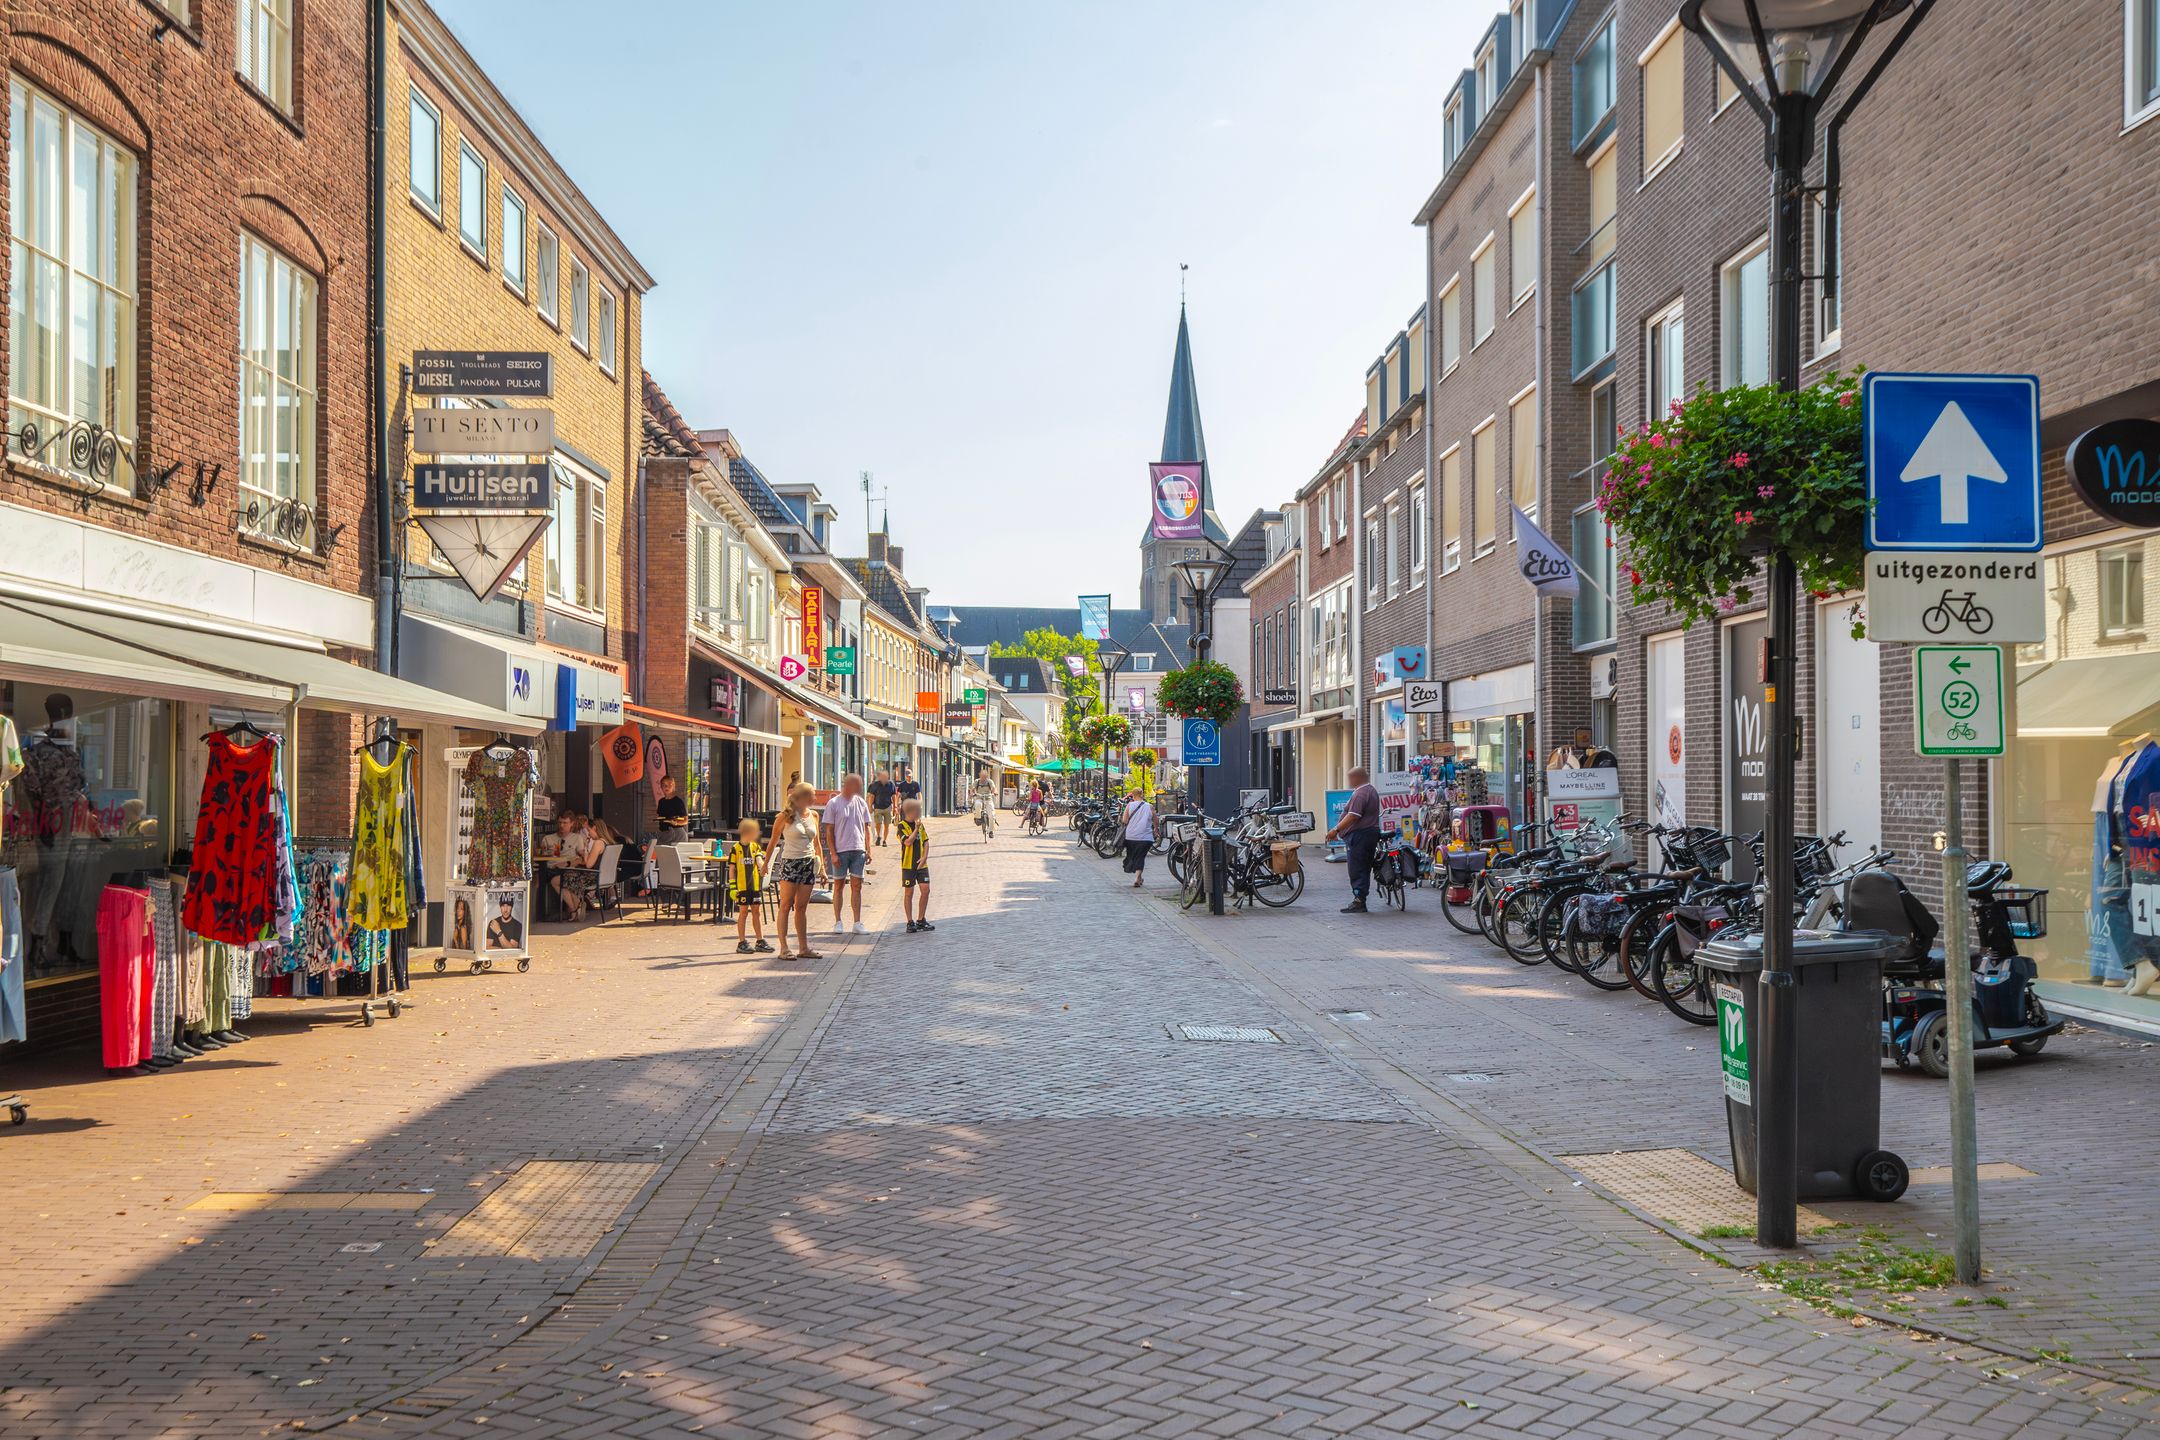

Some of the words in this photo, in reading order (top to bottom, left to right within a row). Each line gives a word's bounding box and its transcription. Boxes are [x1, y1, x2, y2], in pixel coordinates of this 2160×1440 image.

[419, 359, 455, 368] FOSSIL
[461, 361, 501, 369] TROLLBEADS
[506, 360, 542, 369] SEIKO
[419, 373, 455, 387] DIESEL
[506, 379, 541, 388] PULSAR
[423, 417, 445, 433] TI
[459, 417, 539, 433] SENTO
[424, 469, 539, 501] Huijsen
[445, 494, 477, 502] juwelier
[1523, 549, 1571, 578] Etos
[1876, 560, 2037, 584] uitgezonderd
[805, 591, 819, 664] CAFETARIA
[785, 661, 798, 677] B
[827, 659, 852, 668] Pearle
[1265, 691, 1296, 704] shoeby
[1410, 685, 1439, 702] Etos
[1947, 690, 1972, 709] 52
[600, 697, 620, 714] juwelier
[1742, 761, 1766, 777] MOD
[1380, 793, 1423, 810] WAUW
